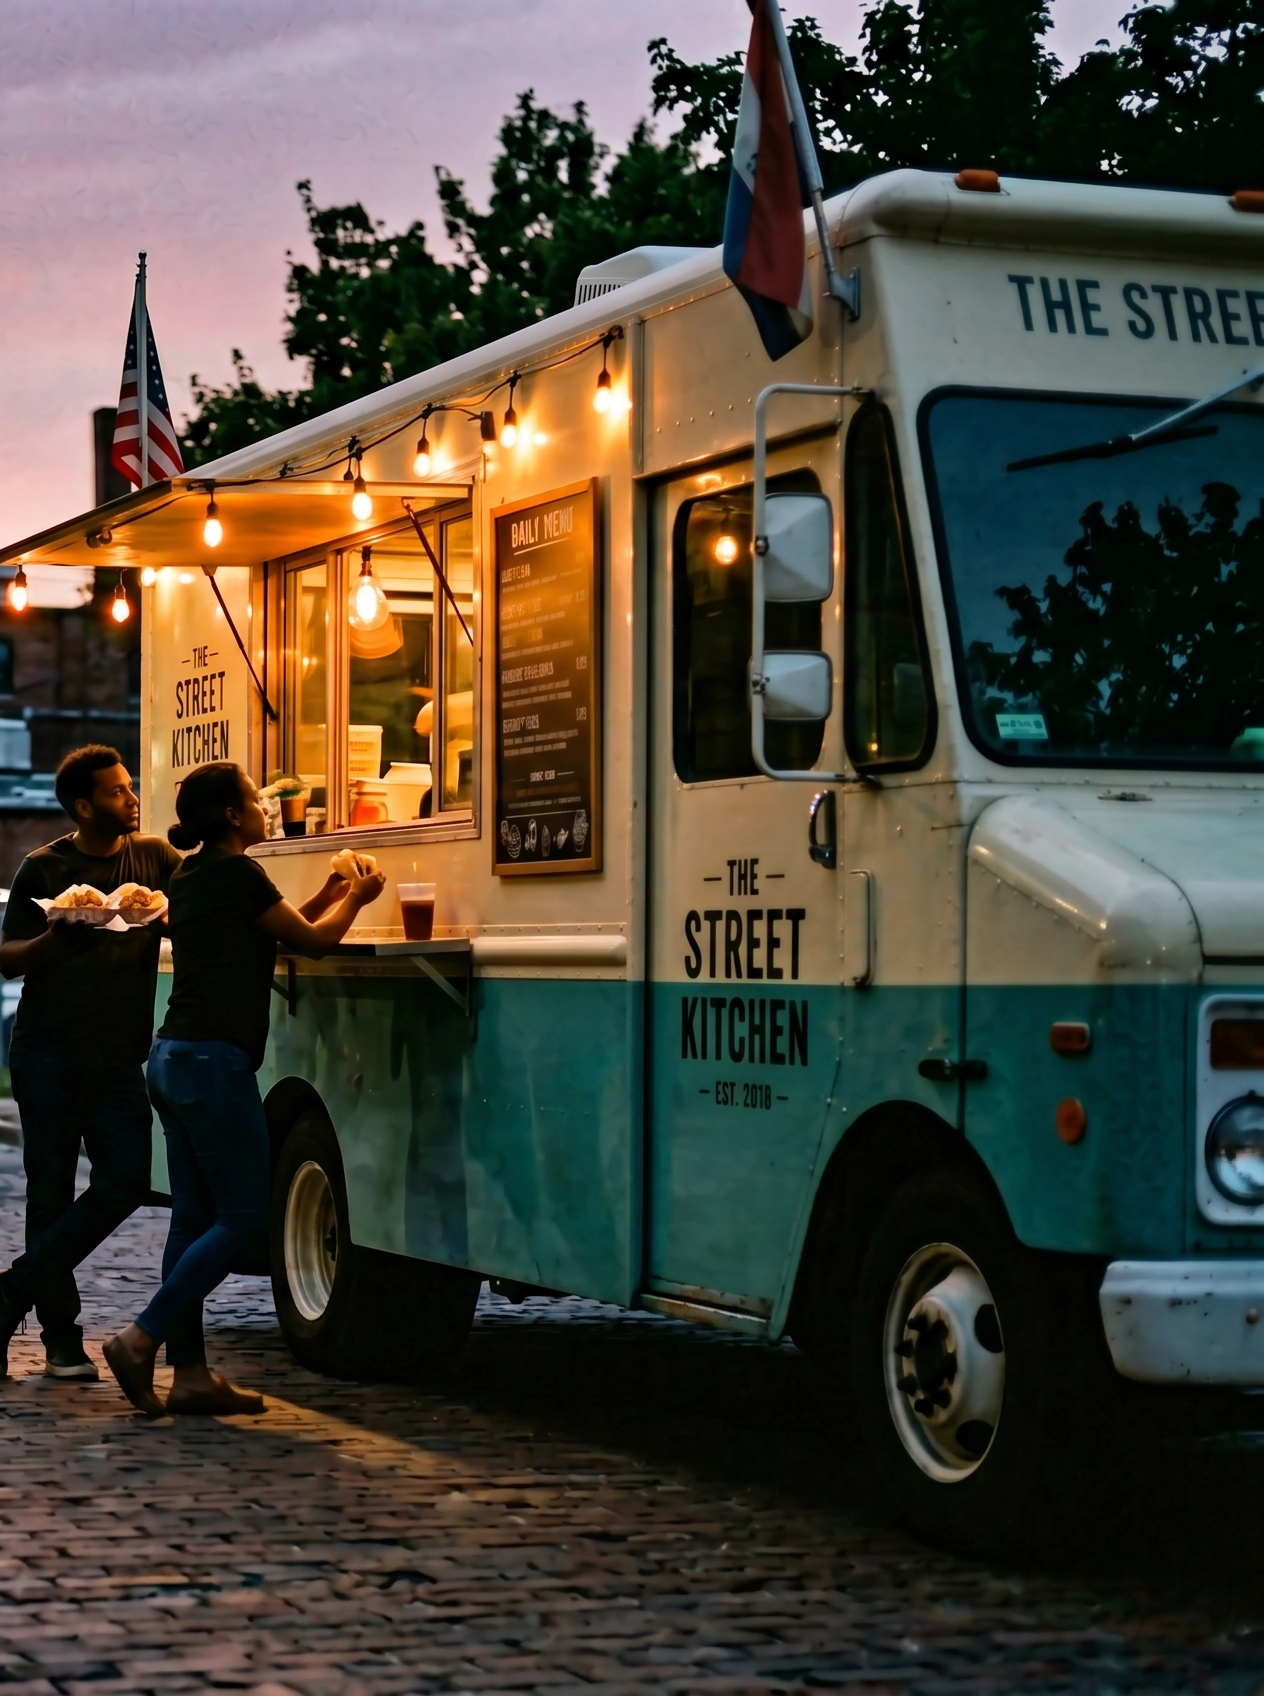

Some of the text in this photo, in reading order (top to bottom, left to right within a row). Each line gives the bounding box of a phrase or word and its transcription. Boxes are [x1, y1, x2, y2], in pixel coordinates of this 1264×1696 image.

[1007, 274, 1109, 336] THE
[511, 517, 540, 548] DAILY
[192, 645, 208, 668] THE
[176, 671, 225, 719] STREET
[172, 719, 229, 768] KITCHEN
[727, 858, 759, 896] THE
[684, 908, 806, 980] STREET
[681, 996, 808, 1067] KITCHEN
[715, 1080, 772, 1110] EST. 2018
